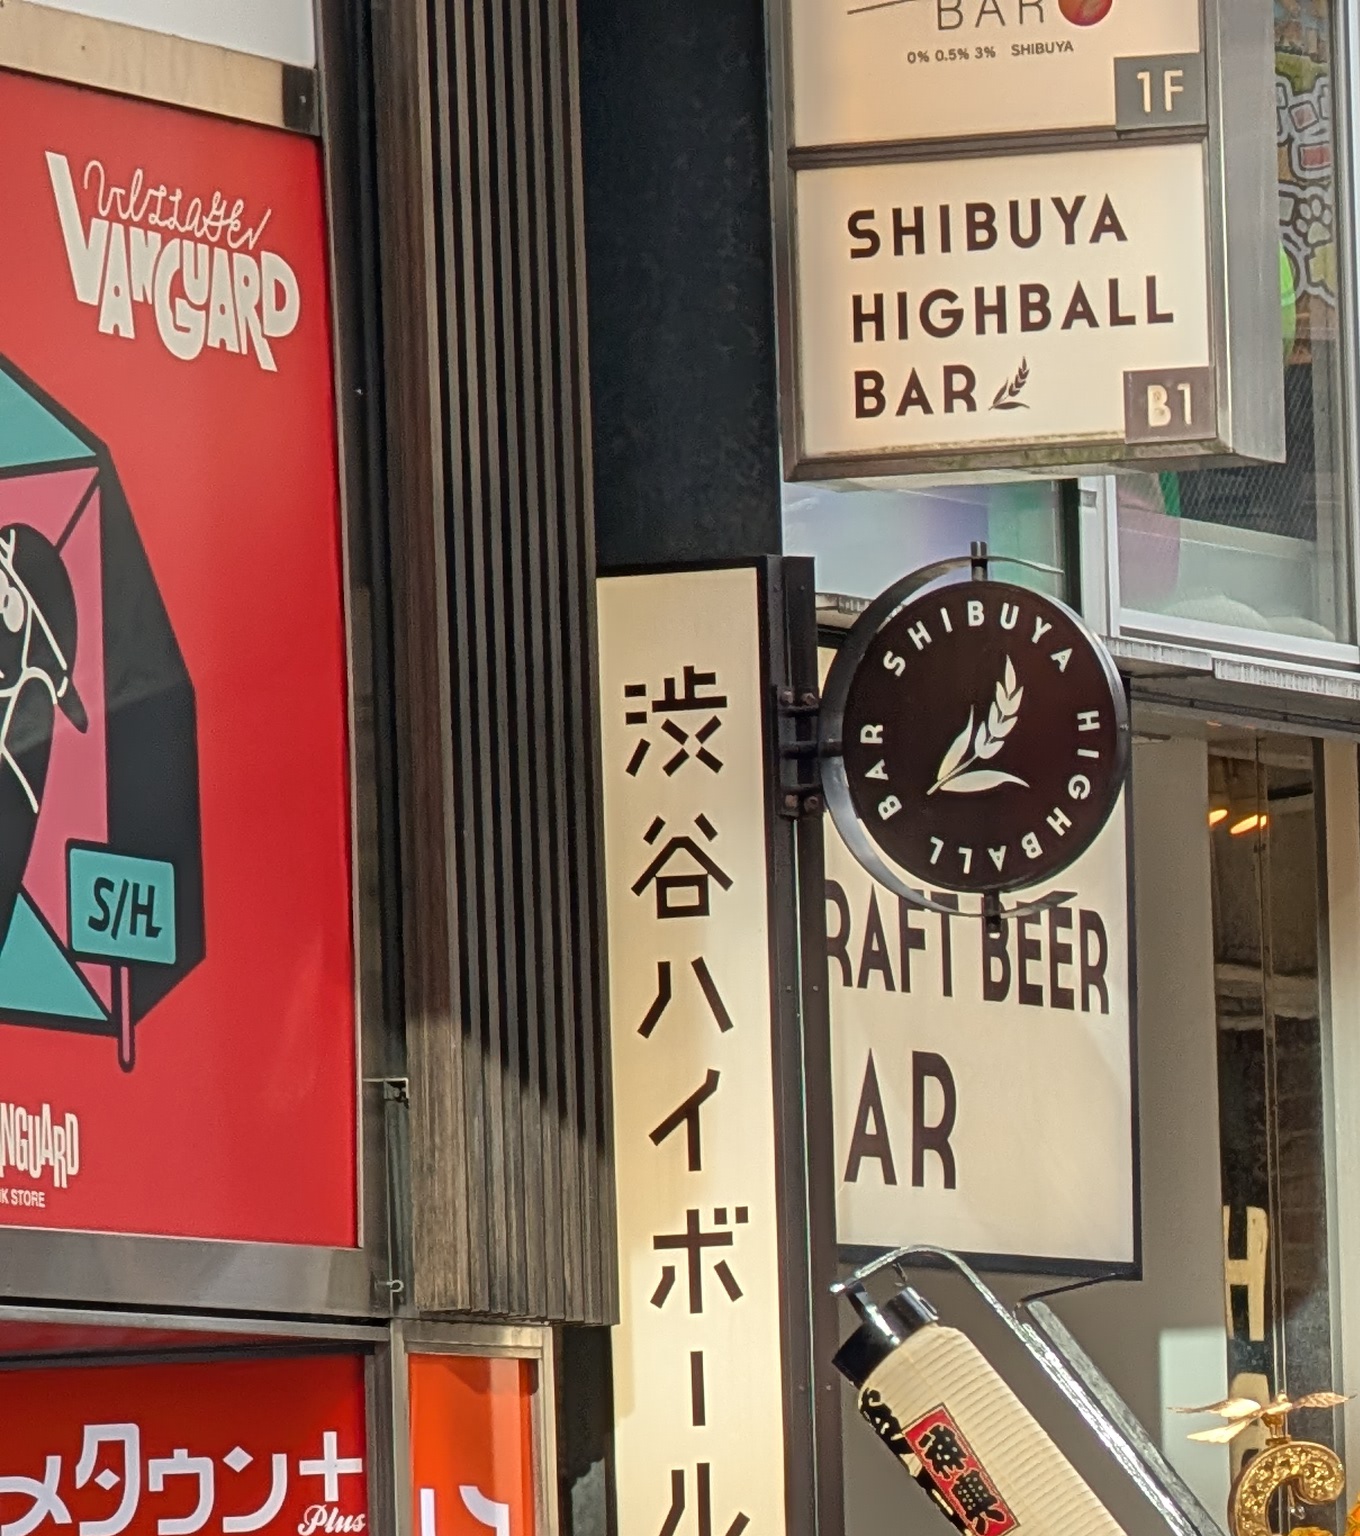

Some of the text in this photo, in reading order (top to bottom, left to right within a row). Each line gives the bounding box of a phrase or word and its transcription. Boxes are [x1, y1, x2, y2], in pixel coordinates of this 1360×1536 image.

[907, 41, 1075, 64] 0% 0.5% 3% SHIBUYA
[1136, 70, 1185, 113] 1F
[847, 193, 1128, 259] SHIBUYA
[45, 150, 301, 372] VANGUARD
[852, 275, 1174, 343] HIGHBALL
[853, 364, 977, 419] BAR
[1146, 383, 1194, 427] B1
[883, 598, 1074, 678] SHIBUYA
[859, 722, 903, 822] BAR
[928, 708, 1101, 875] HIGHBALL
[981, 888, 1111, 1016] BEER
[10, 1188, 46, 1208] STORE
[297, 1504, 366, 1536] Plus
